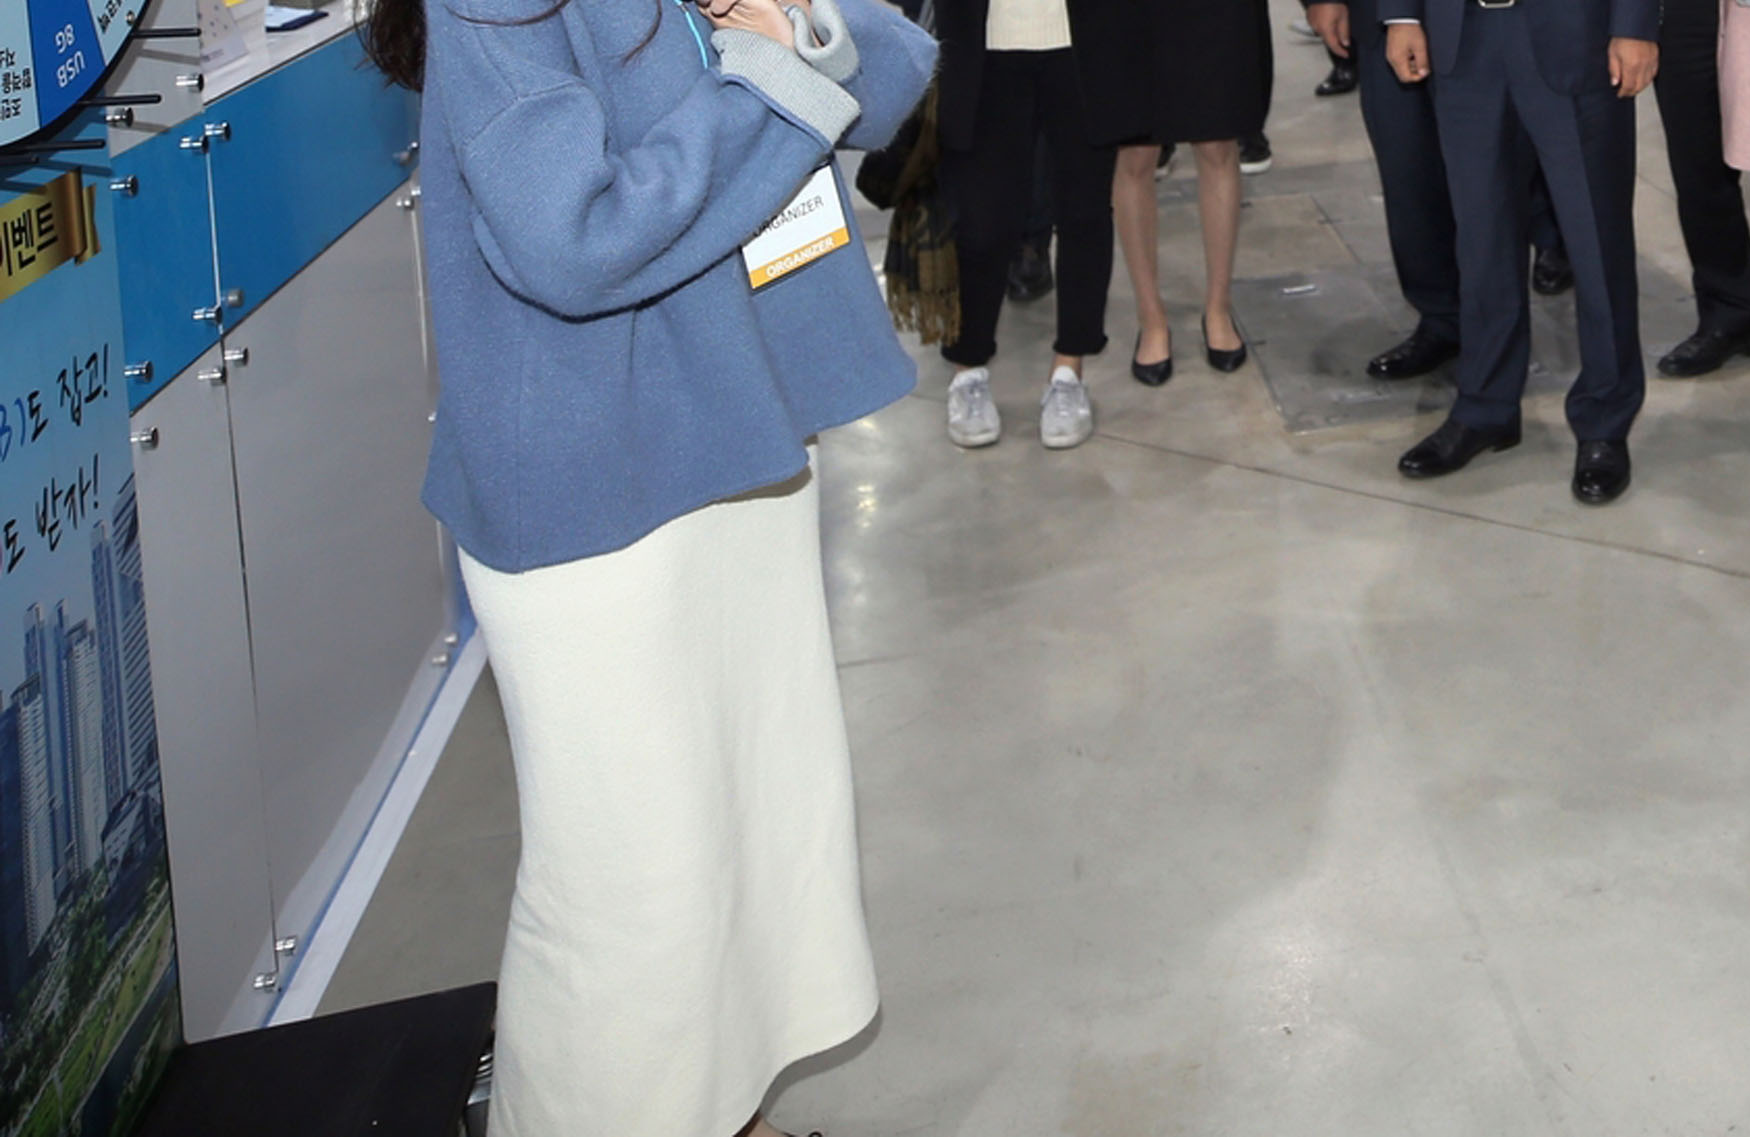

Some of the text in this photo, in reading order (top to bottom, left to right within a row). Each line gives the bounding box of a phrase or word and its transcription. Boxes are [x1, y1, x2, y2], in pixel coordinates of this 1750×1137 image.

[55, 23, 75, 54] 8G
[56, 50, 86, 88] USB
[56, 343, 109, 428] 잡고!
